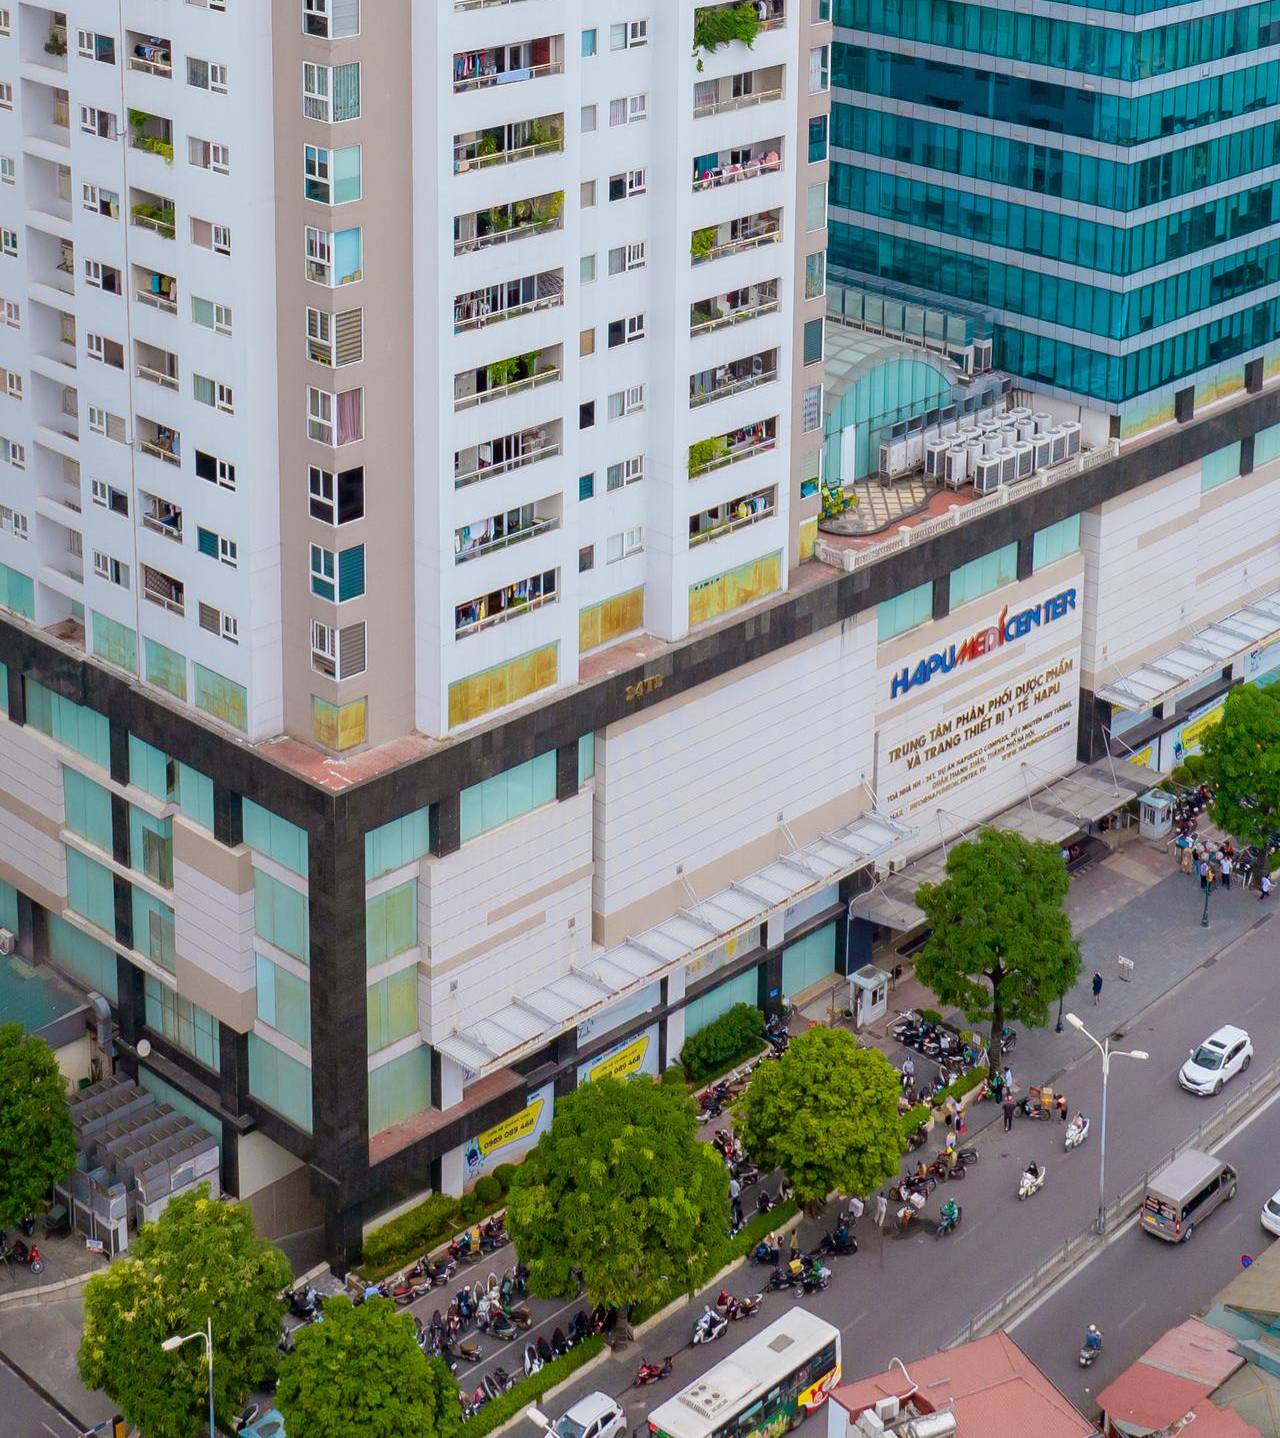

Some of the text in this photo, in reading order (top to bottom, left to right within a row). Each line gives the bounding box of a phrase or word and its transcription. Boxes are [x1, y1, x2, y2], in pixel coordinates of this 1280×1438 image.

[890, 588, 1077, 700] HAPUMEDICENTER
[888, 734, 926, 763] TRUNG
[906, 751, 921, 770] VÀ
[924, 733, 961, 761] TRANG
[964, 713, 993, 741] THIẾT
[1008, 706, 1015, 718] Y
[1034, 682, 1061, 705] HAPU
